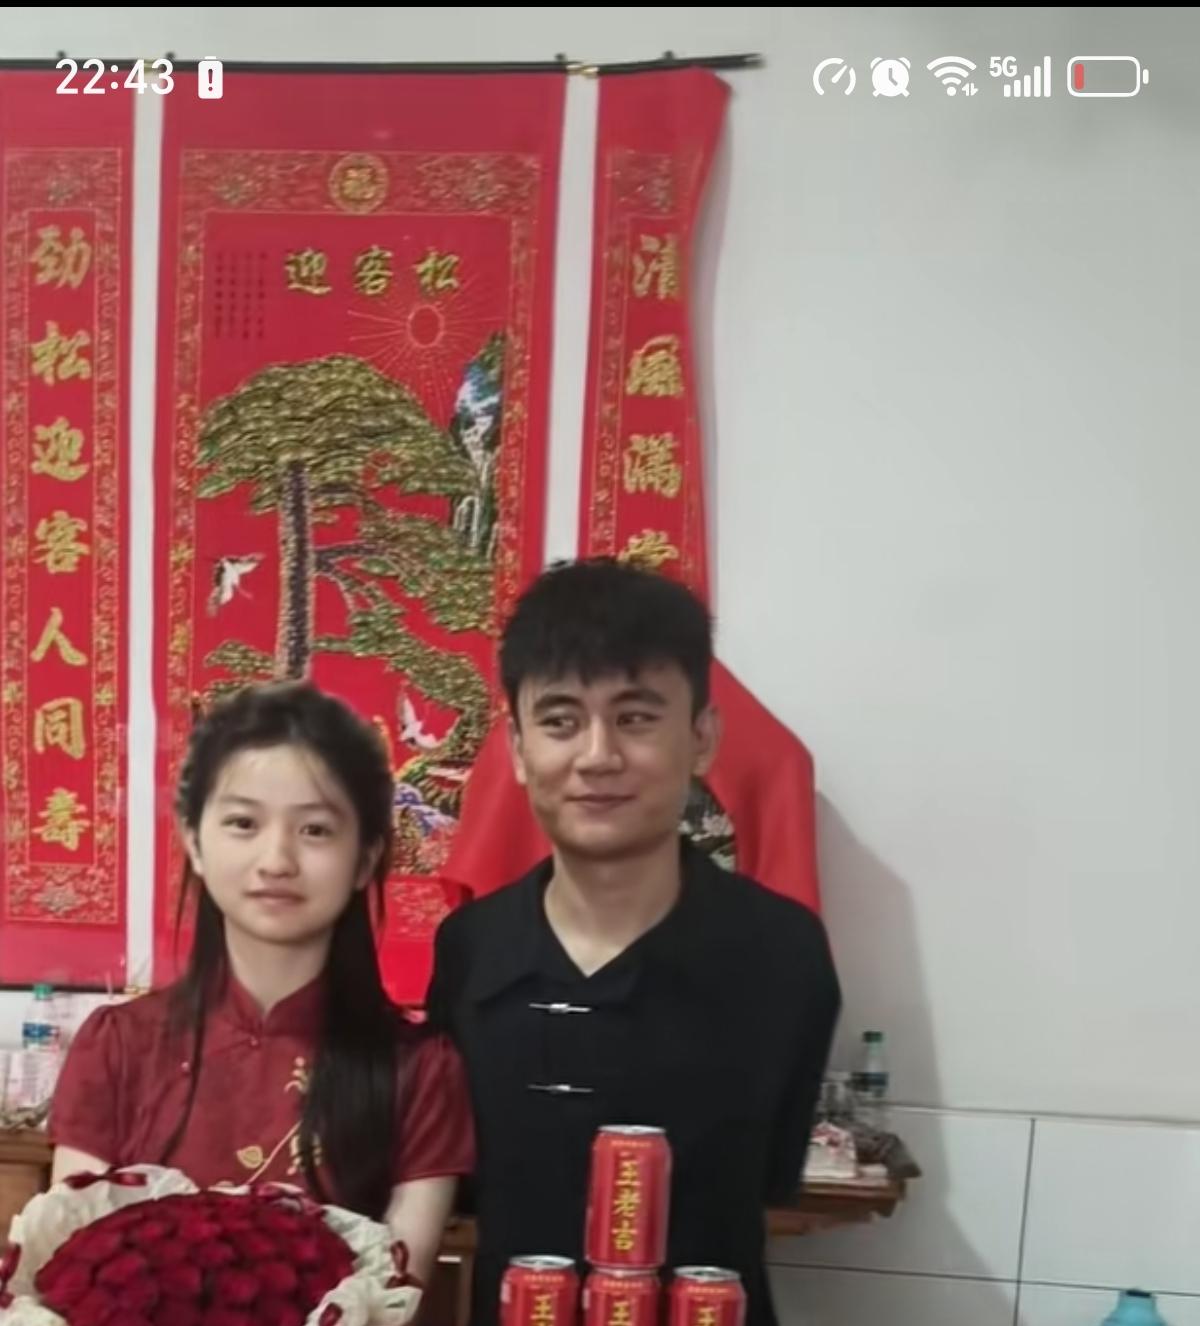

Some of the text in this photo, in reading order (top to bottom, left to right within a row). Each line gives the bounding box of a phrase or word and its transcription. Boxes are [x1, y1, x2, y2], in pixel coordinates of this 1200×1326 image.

[285, 245, 461, 297] 迎客松
[612, 1159, 641, 1251] 王老吉
